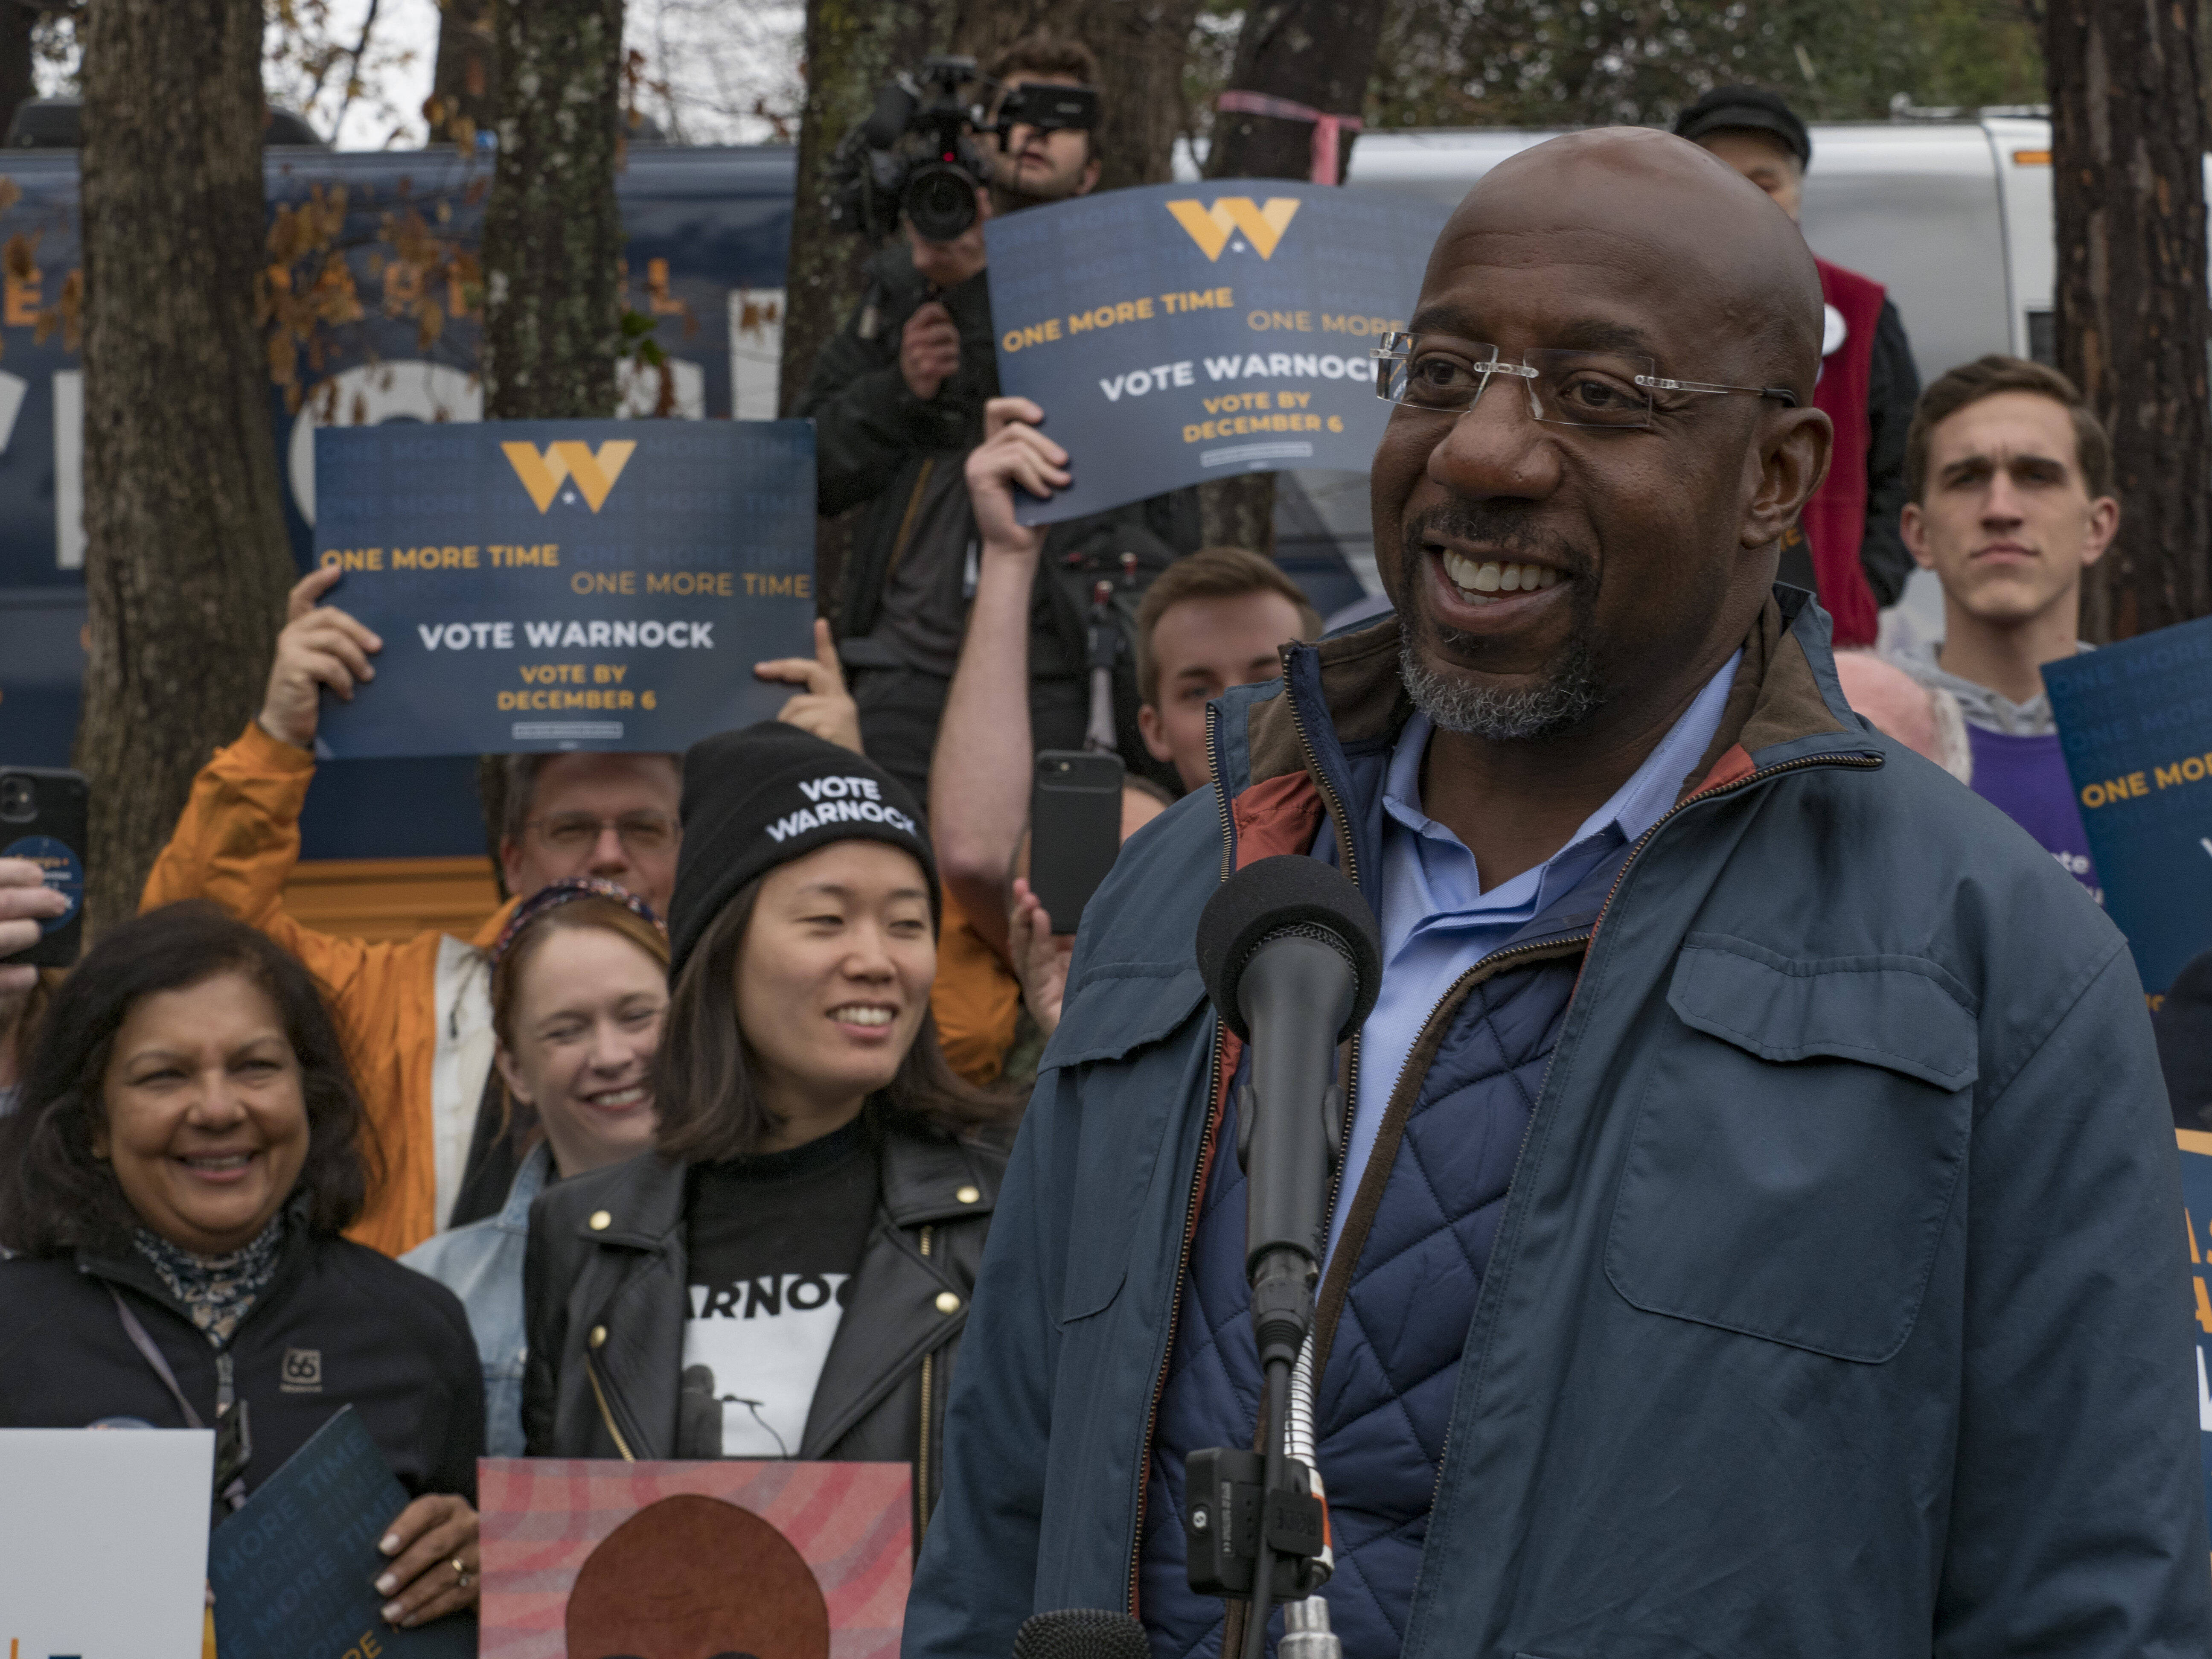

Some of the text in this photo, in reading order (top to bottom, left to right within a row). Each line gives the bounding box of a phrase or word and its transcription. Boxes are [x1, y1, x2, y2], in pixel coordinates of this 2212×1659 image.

[1001, 318, 1062, 352] ONE
[1068, 297, 1154, 335] MORE
[1160, 287, 1234, 314] TIME
[1247, 310, 1313, 332] ONE
[1100, 360, 1195, 402] VOTE
[1202, 391, 1311, 414] VOTE BY
[1182, 414, 1344, 443] DECEMBER 6
[319, 544, 559, 571] ONE MORE TIME
[570, 571, 811, 598] ONE MORE TIME
[418, 620, 714, 650] VOTE WARNOCK
[519, 664, 627, 684] VOTE BY
[497, 690, 657, 710] DECEMBER 6
[798, 775, 882, 802] VOTE
[2081, 771, 2149, 808] ONE
